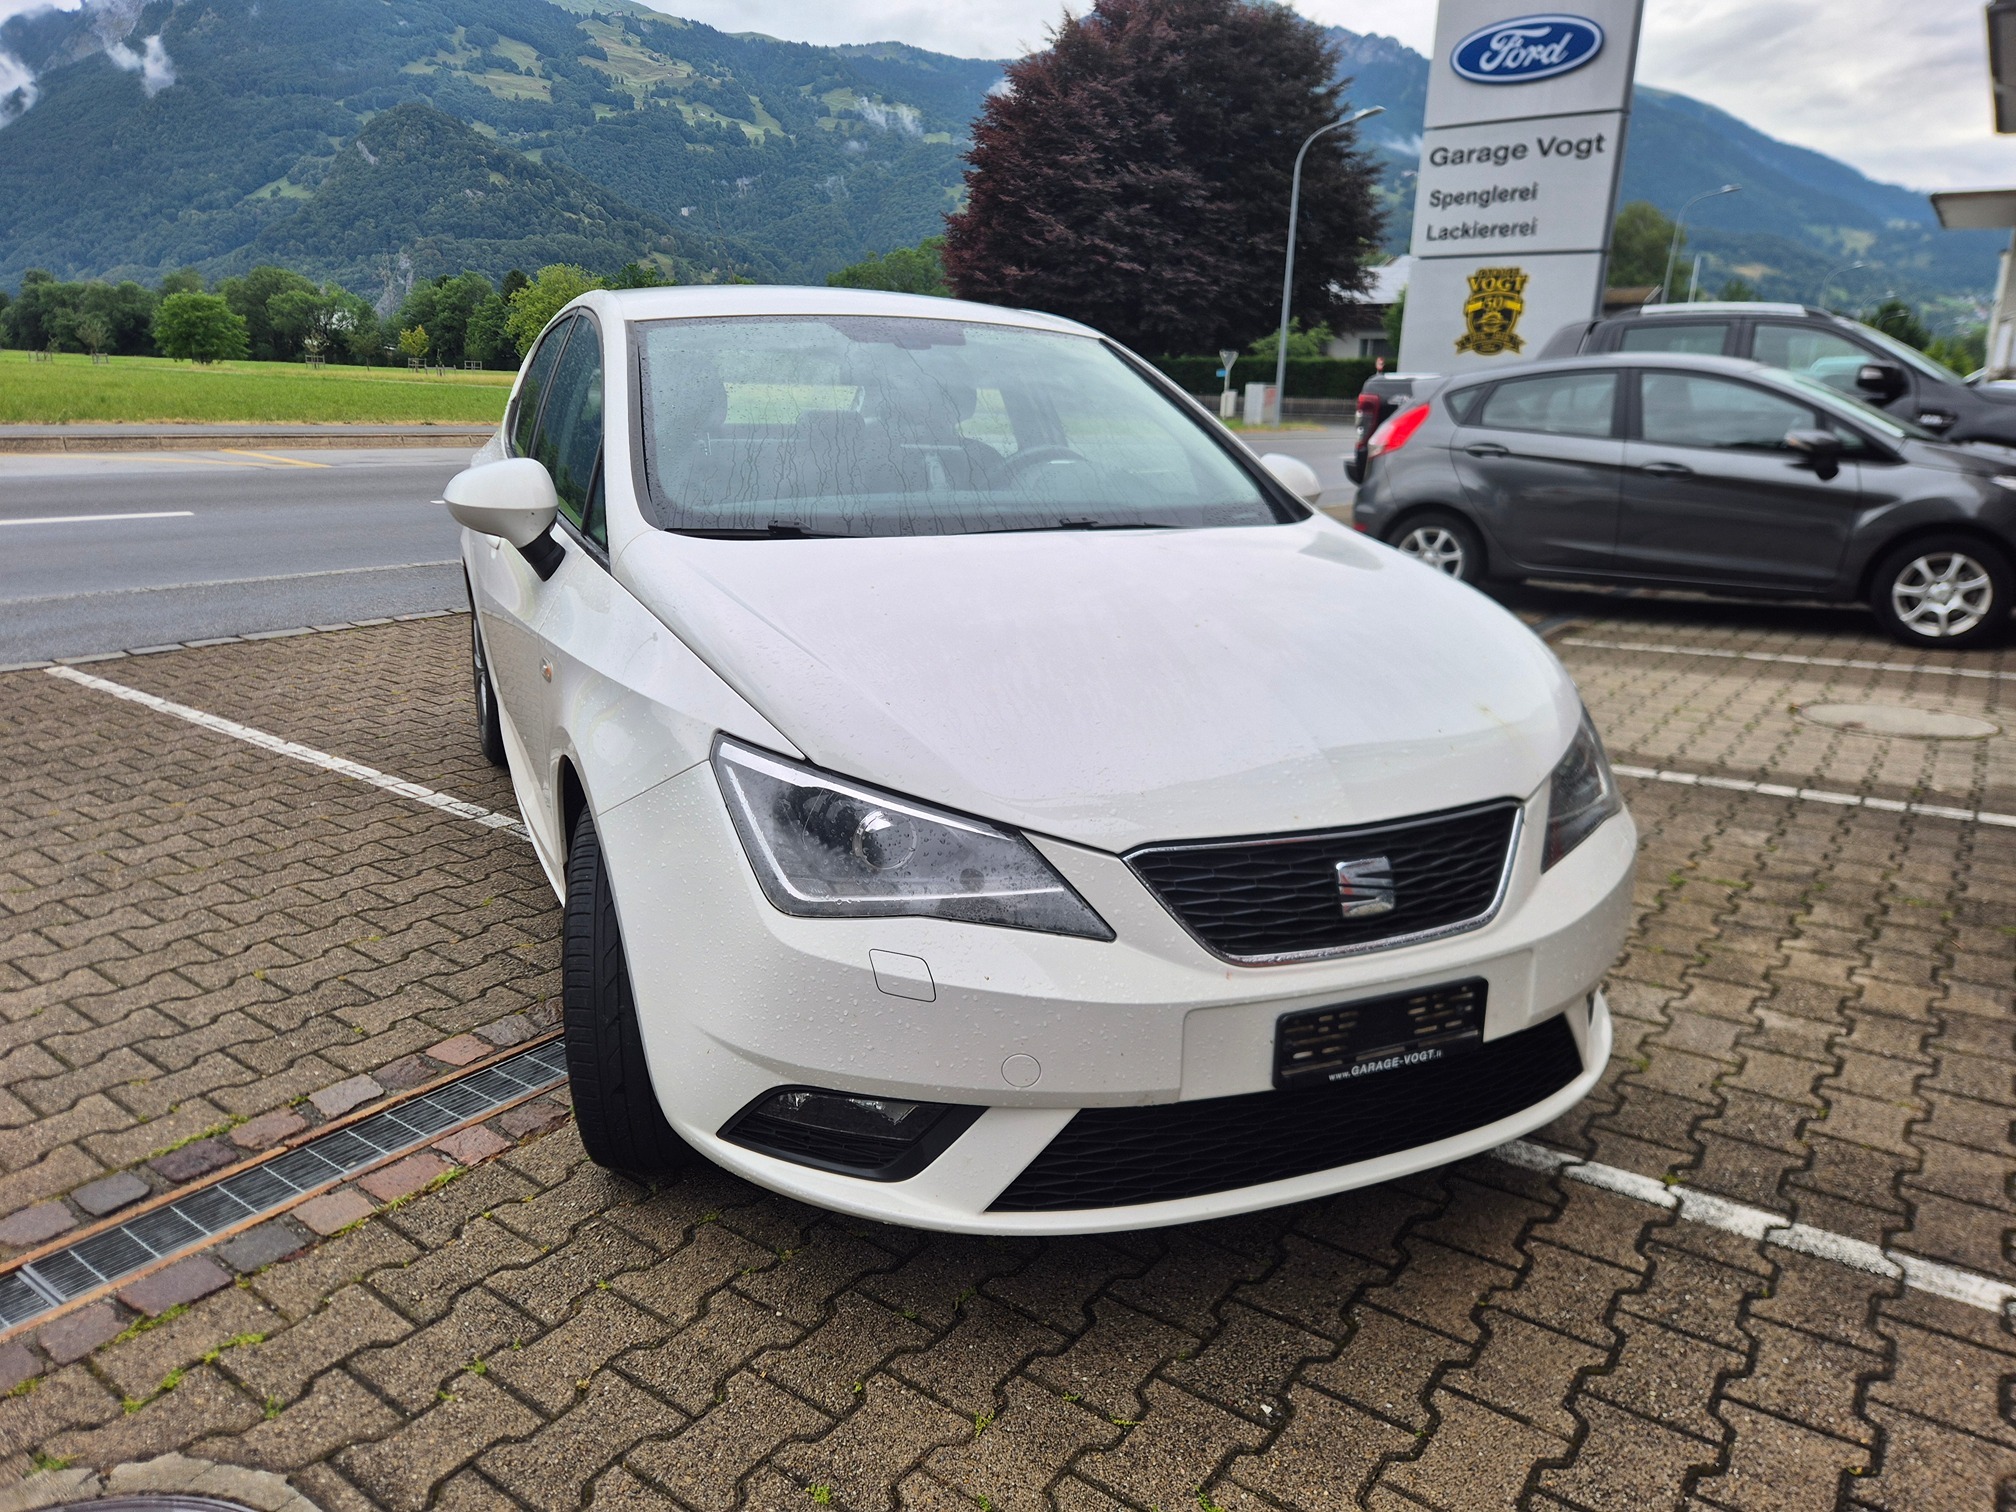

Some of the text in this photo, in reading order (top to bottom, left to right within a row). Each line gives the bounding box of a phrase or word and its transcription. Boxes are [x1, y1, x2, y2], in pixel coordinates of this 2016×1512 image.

[1479, 26, 1574, 71] Ford
[1429, 132, 1606, 167] Garage Vogt
[1429, 182, 1539, 210] Spenglerei
[1426, 217, 1538, 242] Lackiererei
[1468, 275, 1526, 292] VOGT
